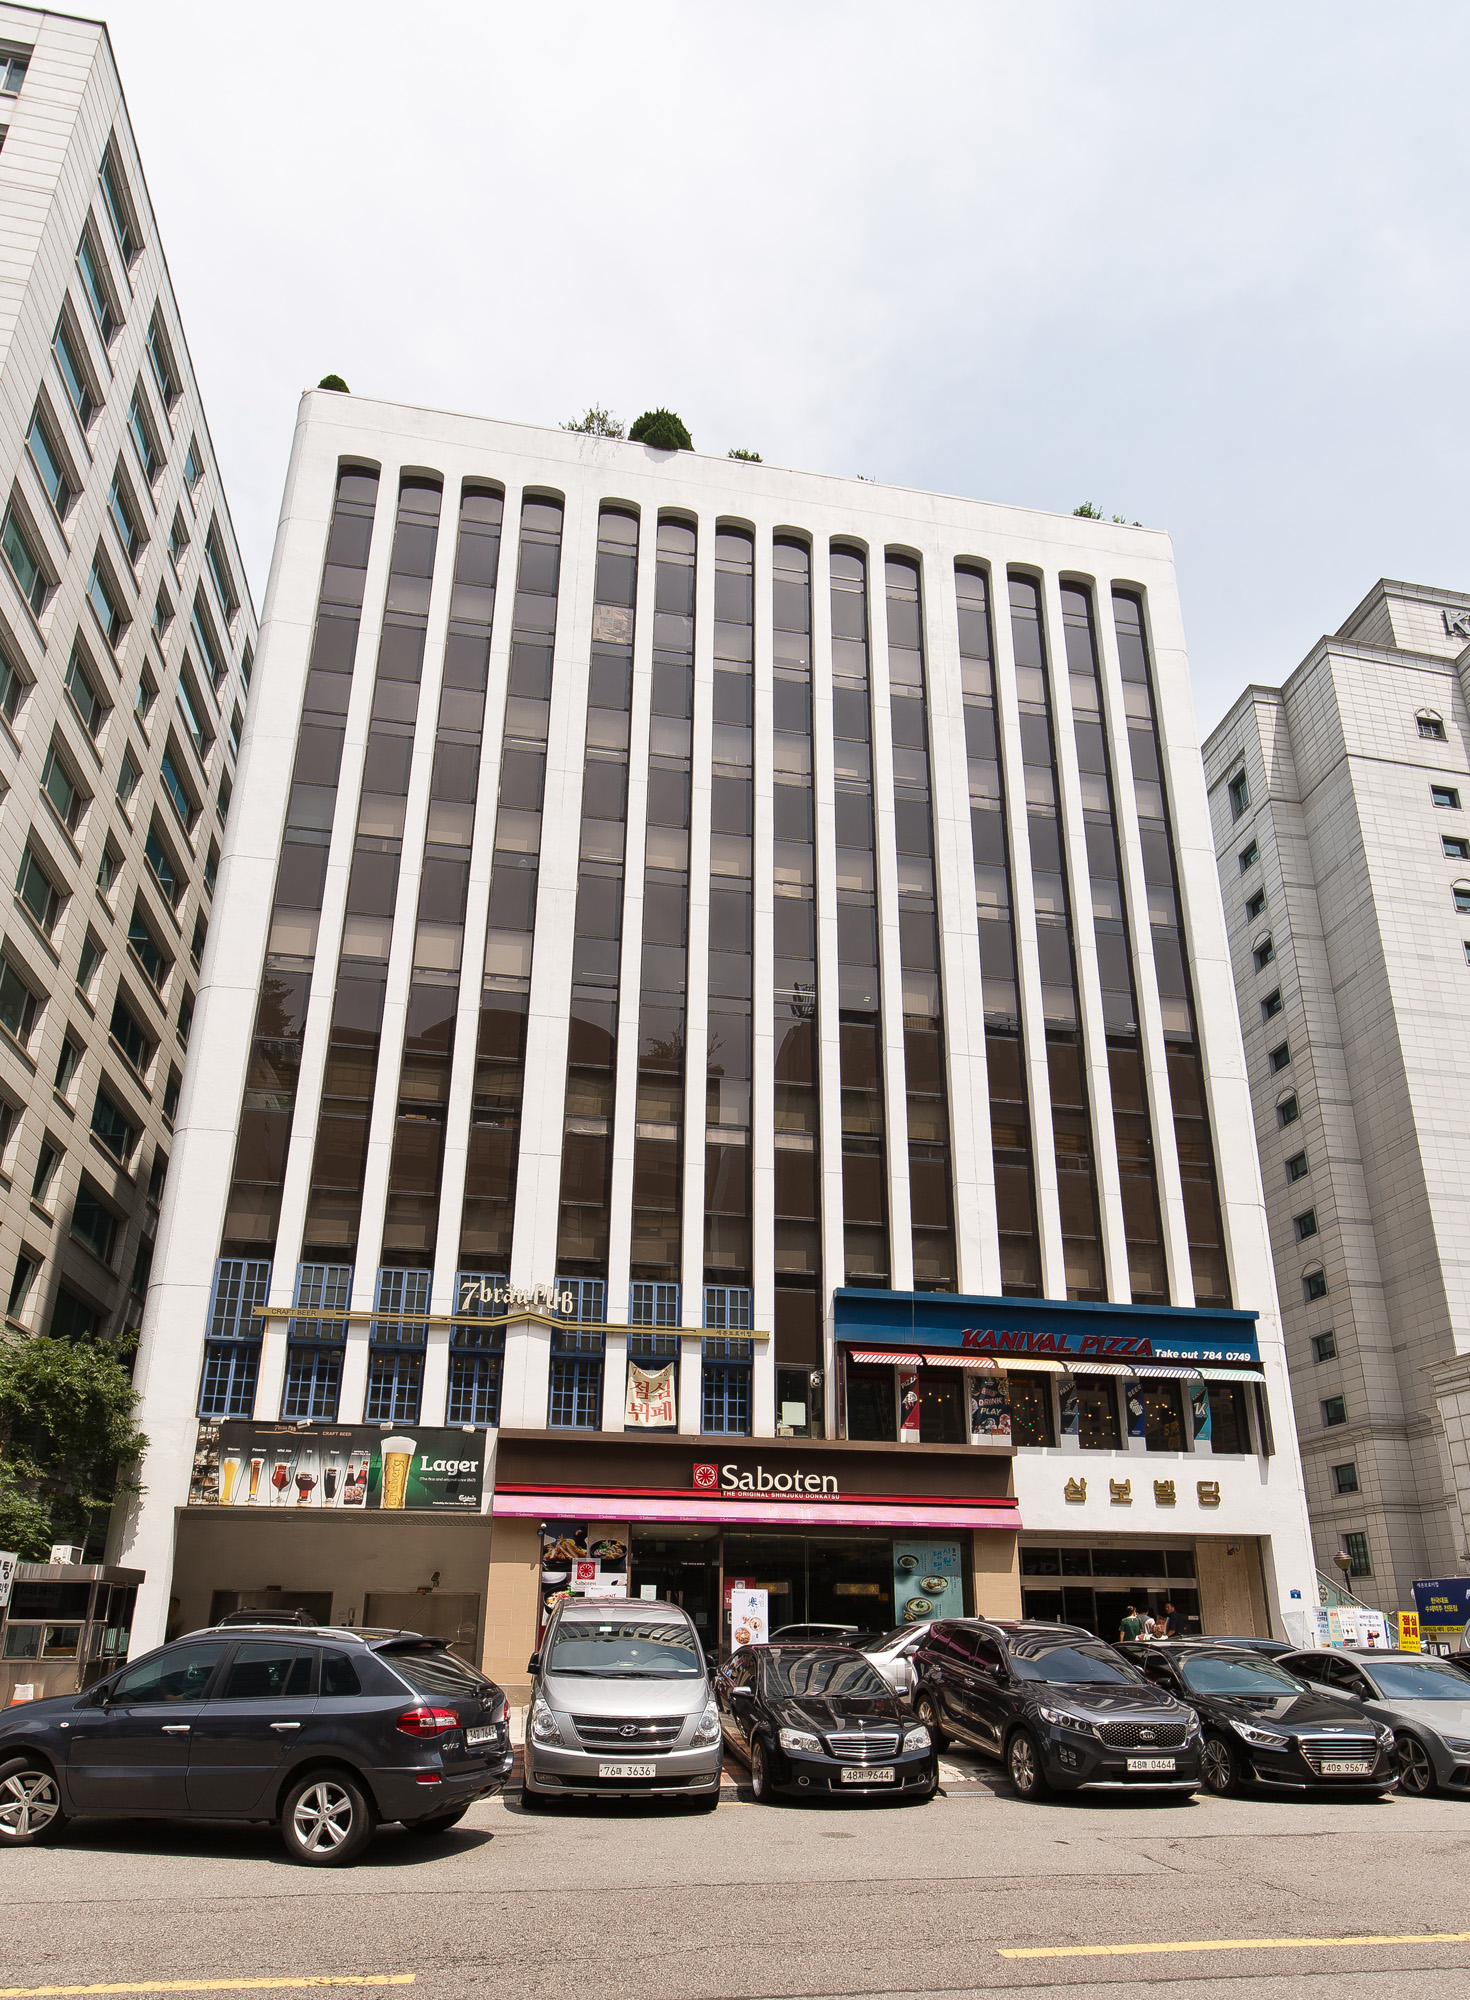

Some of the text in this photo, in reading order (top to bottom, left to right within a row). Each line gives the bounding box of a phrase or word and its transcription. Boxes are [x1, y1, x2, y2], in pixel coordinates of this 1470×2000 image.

[271, 1308, 295, 1316] CRAFT
[961, 1328, 1153, 1356] KANIVAL PIZZA
[1155, 1349, 1251, 1361] Take out 784 0749
[630, 1379, 671, 1400] 점심
[1059, 1381, 1076, 1396] PASTA
[1127, 1384, 1142, 1398] BEER
[978, 1397, 1003, 1407] DRINK
[627, 1401, 672, 1423] 뷔페
[980, 1407, 1002, 1416] PLAY
[420, 1455, 479, 1476] Lager
[721, 1464, 838, 1493] Saboten
[1064, 1477, 1221, 1505] 삼보빌딩
[0, 1560, 14, 1580] 탕
[1402, 1615, 1417, 1626] 점심
[1403, 1626, 1418, 1638] 뷔페
[1151, 1760, 1171, 1769] 0464
[1345, 1763, 1364, 1772] 9567
[627, 1766, 651, 1776] 3636
[867, 1770, 889, 1780] 9644
